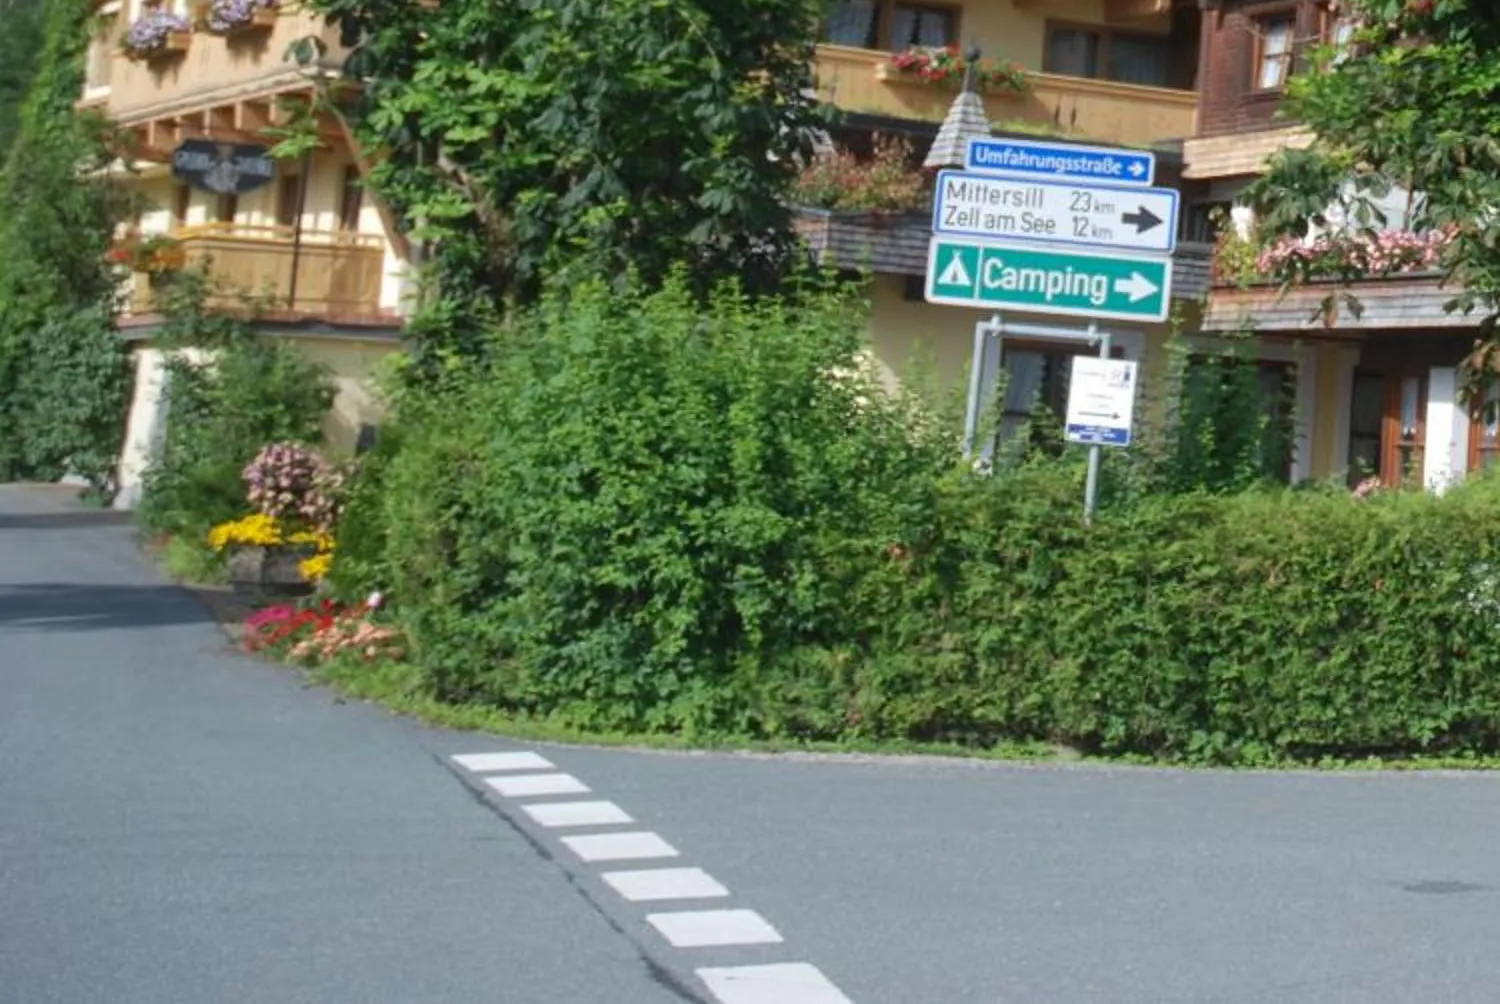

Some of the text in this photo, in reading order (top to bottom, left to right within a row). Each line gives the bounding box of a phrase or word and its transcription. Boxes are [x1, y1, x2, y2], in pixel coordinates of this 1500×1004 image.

[975, 145, 1123, 175] Umfahrungsstraße
[946, 180, 1116, 214] Mittersill 23 km
[944, 205, 1113, 240] Zell am See 12 km
[982, 257, 1109, 305] Camping
